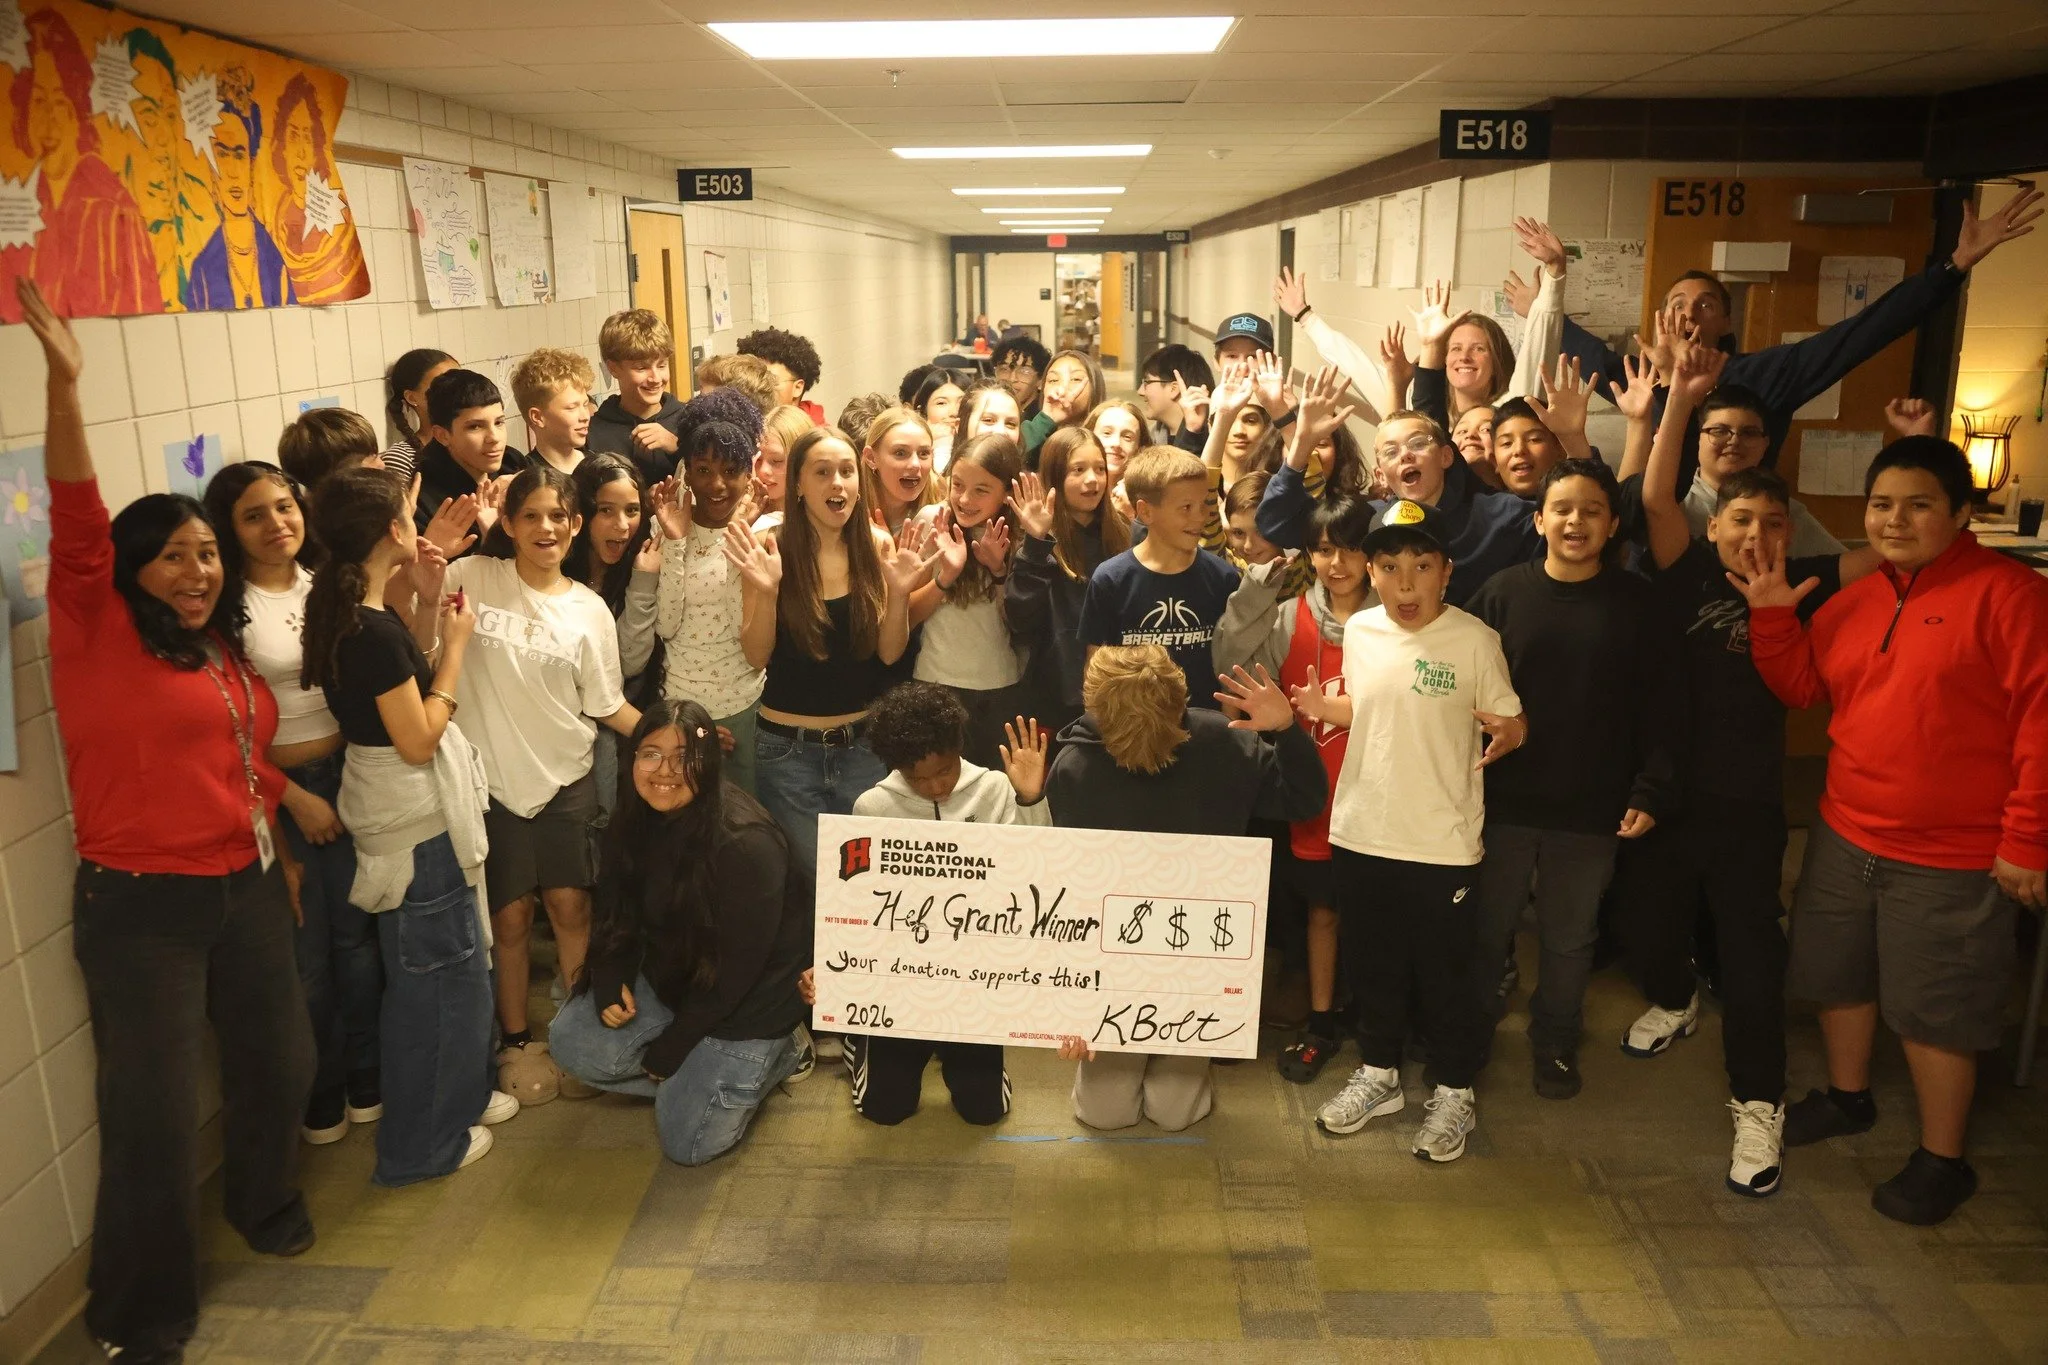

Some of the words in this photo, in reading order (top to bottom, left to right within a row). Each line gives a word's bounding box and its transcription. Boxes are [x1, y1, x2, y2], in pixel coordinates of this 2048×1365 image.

[1457, 119, 1528, 150] E518
[695, 174, 744, 195] E503
[1664, 181, 1746, 217] E518
[1122, 629, 1213, 646] BASKETBALL
[518, 649, 575, 672] NGELES
[1424, 668, 1456, 681] PUNTA
[881, 838, 958, 854] HOLLAND
[839, 837, 871, 882] H
[880, 851, 996, 868] EDUCATIONAL
[880, 864, 987, 881] FOUNDATION
[944, 892, 1022, 941] Grant
[1029, 884, 1100, 943] Winner
[1165, 904, 1190, 951] $
[1209, 907, 1234, 951] $
[891, 957, 961, 979] donation
[969, 966, 1042, 990] supports
[1049, 966, 1101, 993] this!
[1223, 987, 1243, 995] DOLLARS
[822, 1015, 835, 1023] MEMO
[846, 1002, 894, 1028] 2026
[1009, 1031, 1028, 1039] HOLLAND
[1028, 1032, 1056, 1041] EDUCATIONAL
